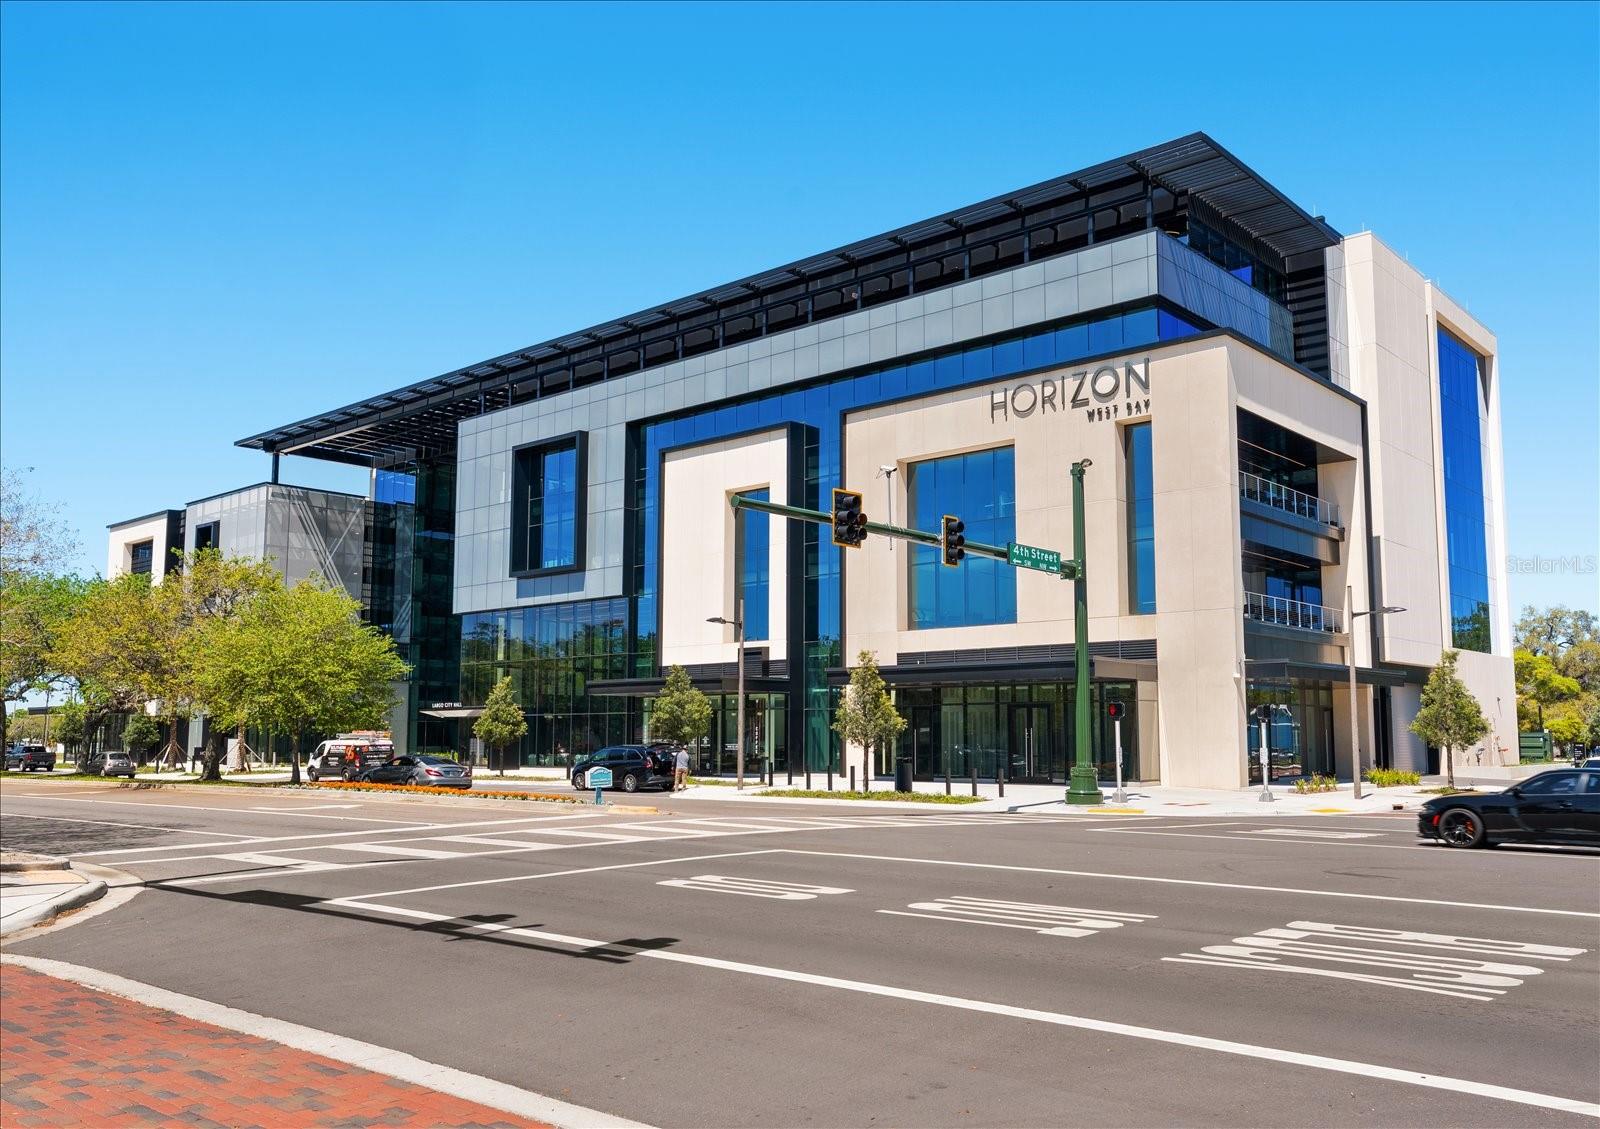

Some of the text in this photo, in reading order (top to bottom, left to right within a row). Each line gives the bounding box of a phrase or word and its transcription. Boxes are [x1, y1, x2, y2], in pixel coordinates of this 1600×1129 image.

[991, 358, 1150, 421] HORIZON
[1087, 399, 1150, 421] WEST BAY
[1013, 545, 1058, 563] 4th Street
[1161, 921, 1588, 1001] BLOCK
